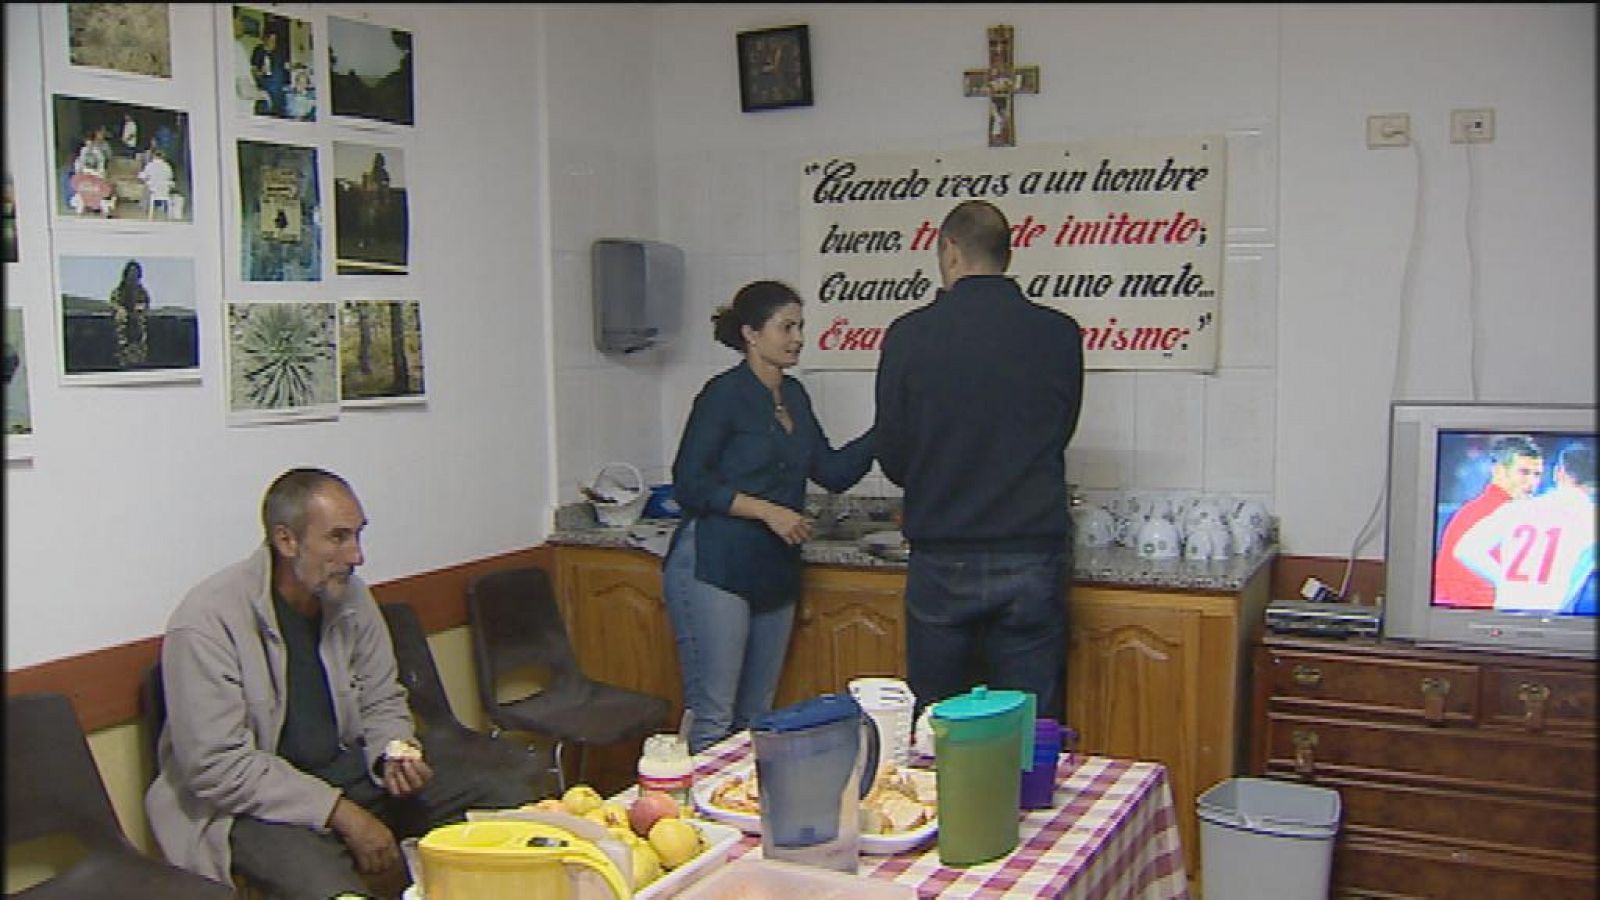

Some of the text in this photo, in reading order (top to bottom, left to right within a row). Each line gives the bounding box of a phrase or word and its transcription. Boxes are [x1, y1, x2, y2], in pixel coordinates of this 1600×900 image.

[935, 174, 1013, 198] veas
[1092, 157, 1210, 192] hombre
[818, 269, 931, 302] Cuando
[1505, 523, 1563, 585] 21
